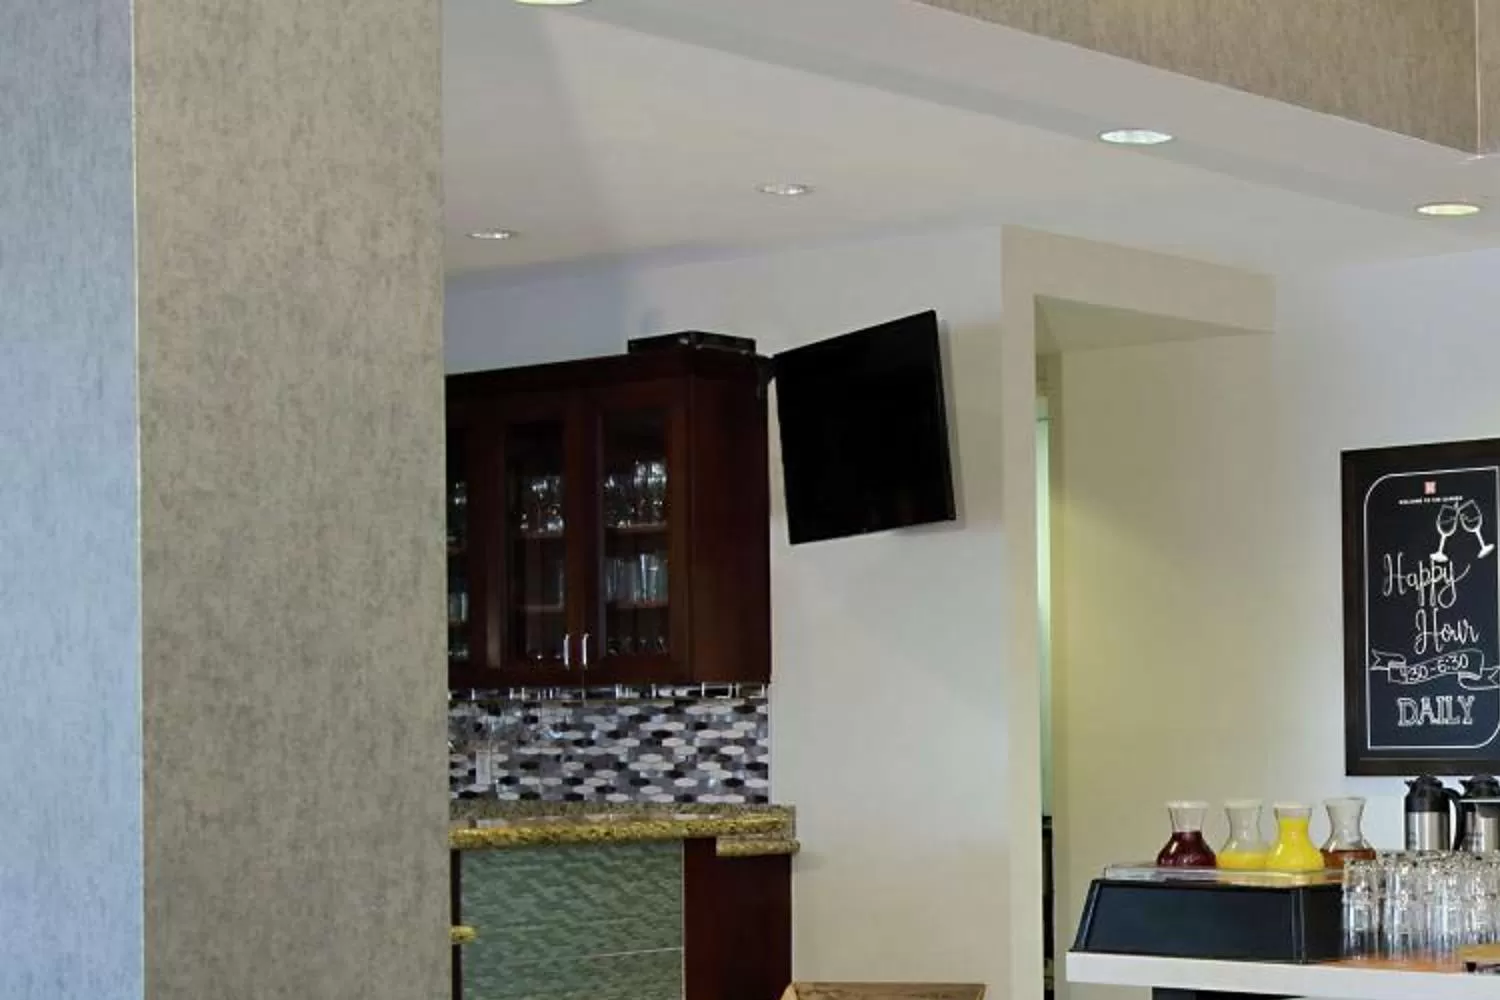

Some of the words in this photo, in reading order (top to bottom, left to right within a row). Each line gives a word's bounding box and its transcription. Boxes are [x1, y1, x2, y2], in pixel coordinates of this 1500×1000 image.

[1383, 553, 1471, 608] Happy
[1414, 607, 1480, 654] Hour
[1397, 695, 1475, 727] DAILY
